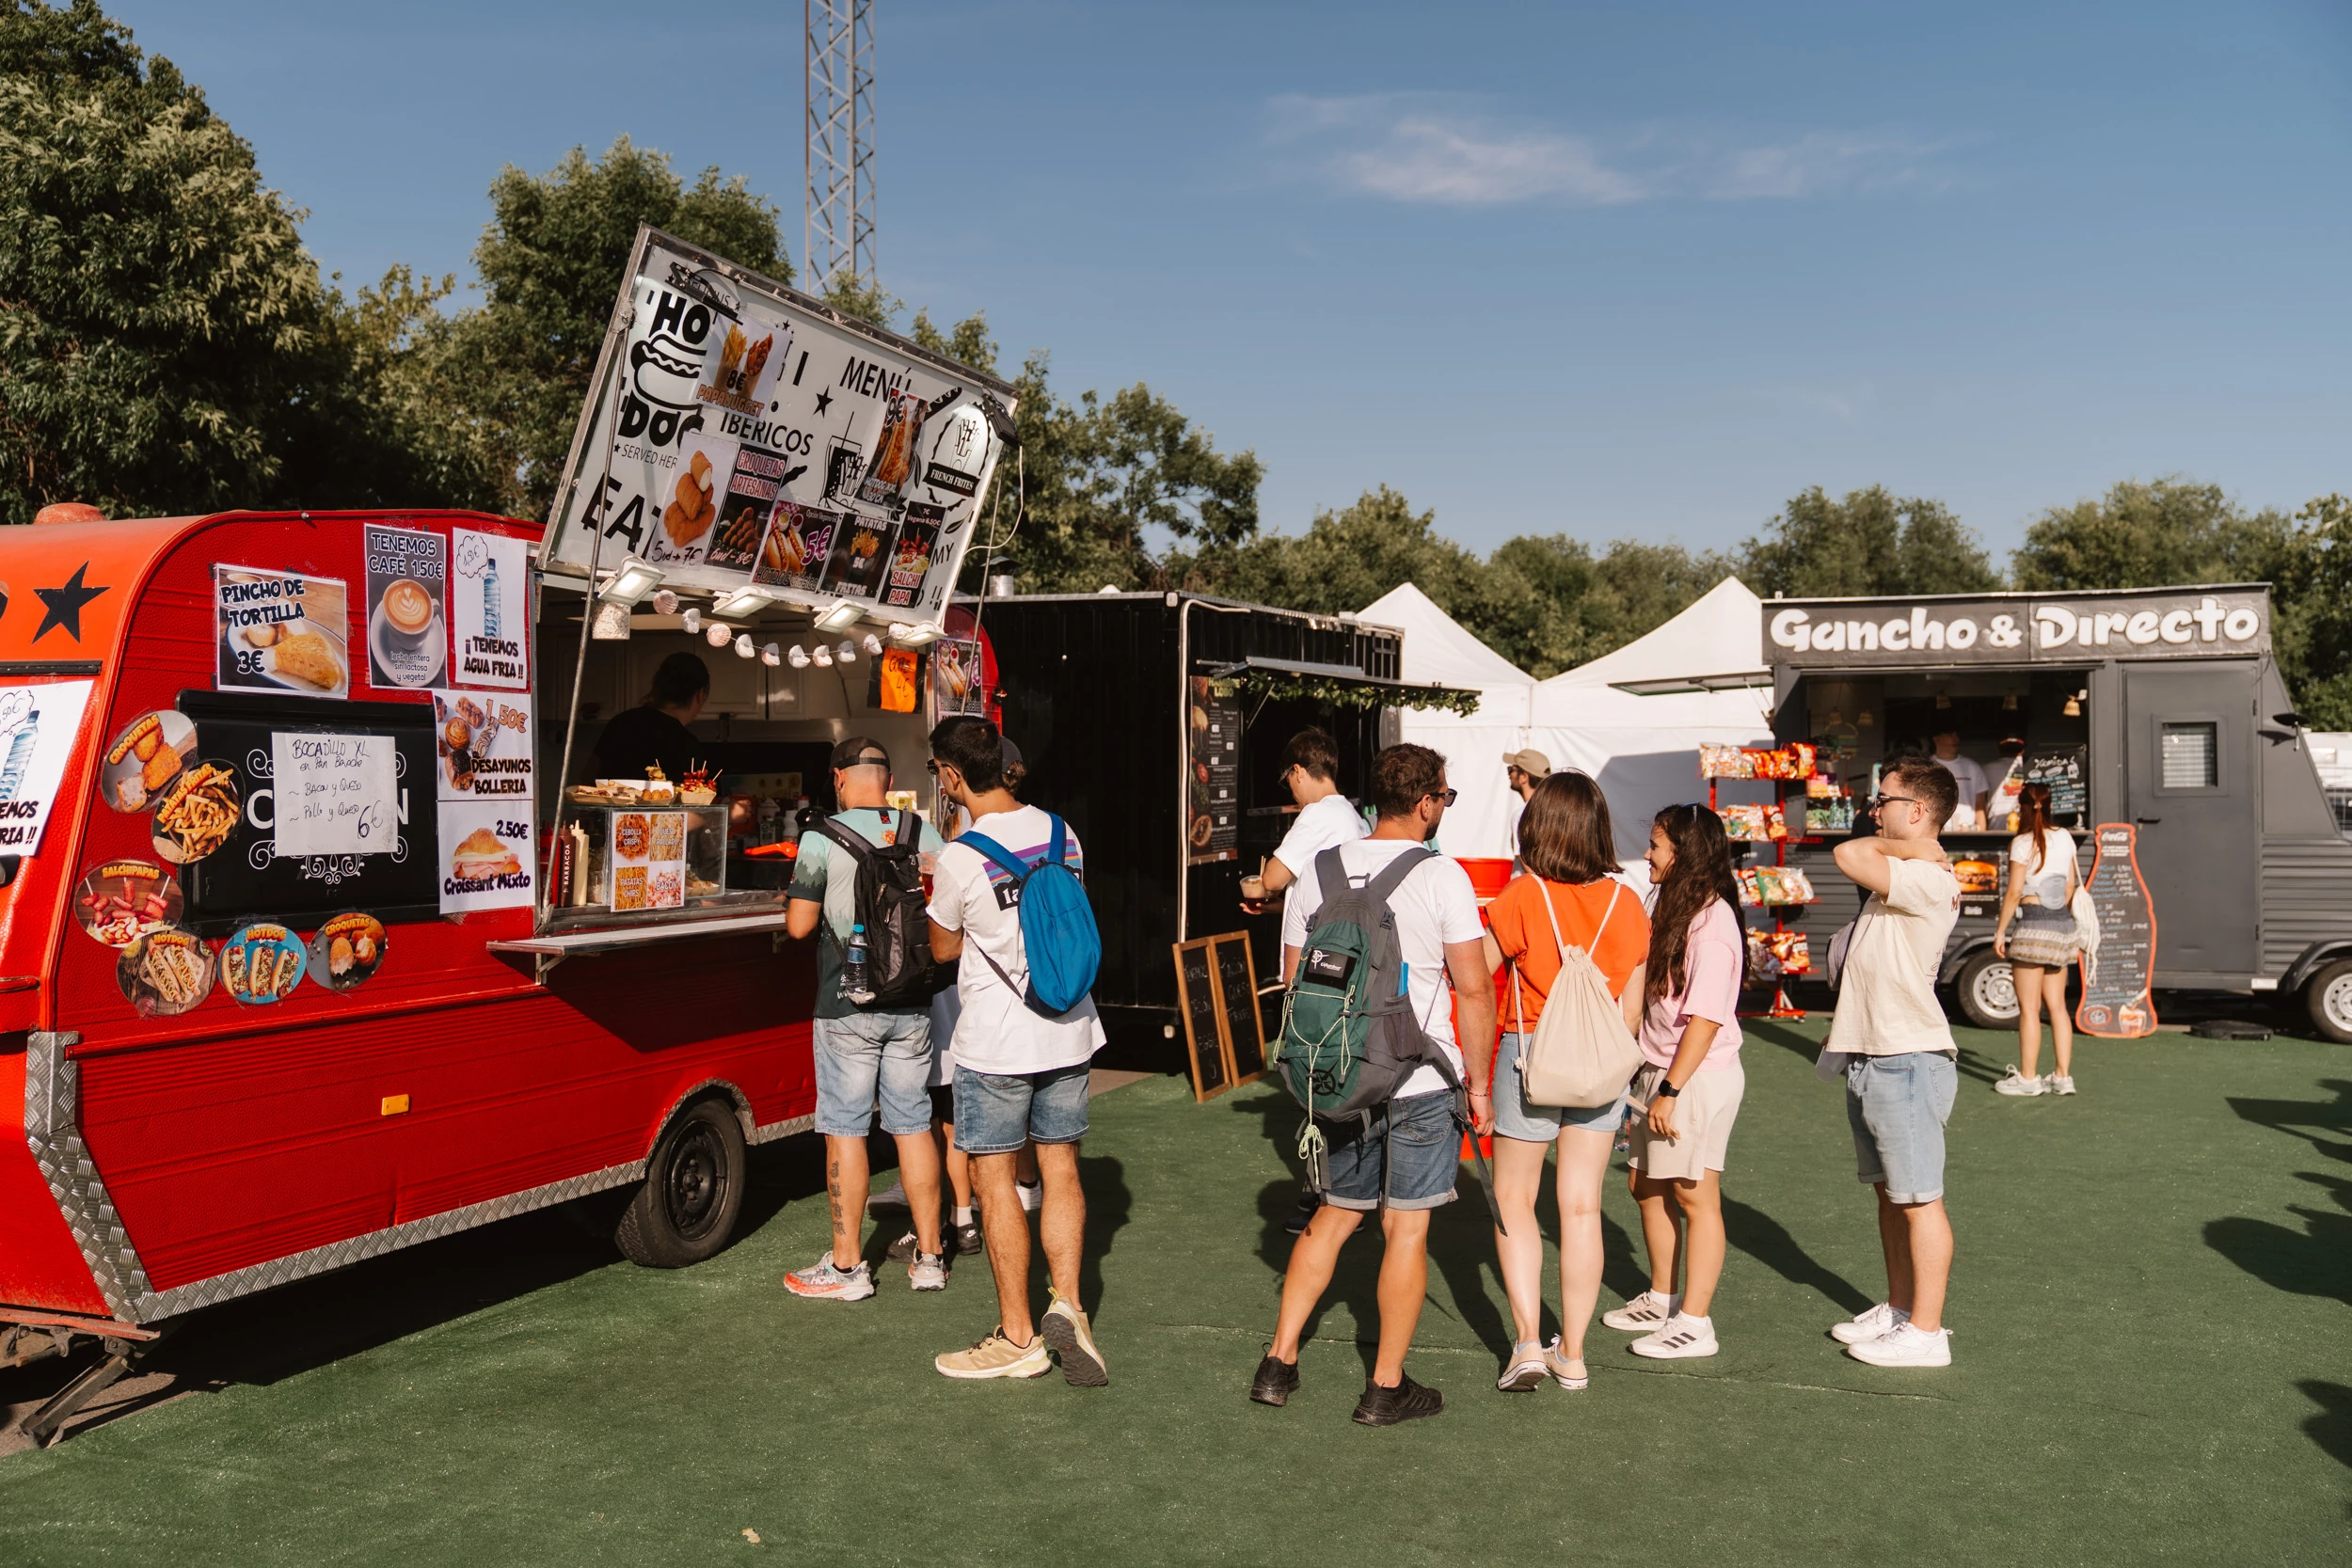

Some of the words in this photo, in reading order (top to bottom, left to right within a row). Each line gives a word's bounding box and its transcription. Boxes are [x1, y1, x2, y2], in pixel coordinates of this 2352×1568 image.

[649, 291, 718, 345] HO
[726, 370, 747, 391] 8€
[696, 384, 765, 419] PAPANUGGET
[885, 395, 906, 428] 9€
[621, 443, 659, 466] SERVED
[659, 456, 678, 469] HER
[737, 450, 786, 480] CROQUETAS
[729, 473, 779, 502] ARTESANAS
[864, 476, 886, 488] HOTDOG
[930, 467, 953, 485] FRENCH
[952, 475, 975, 490] FRITES
[854, 515, 888, 531] PATATAS
[371, 532, 436, 556] TENEMOS
[801, 525, 832, 565] 5€
[368, 553, 406, 575] CAFÉ
[411, 561, 443, 579] 1.50€
[684, 546, 703, 566] 7€
[736, 551, 754, 565] 8€
[852, 556, 866, 569] 5€
[755, 565, 792, 585] HOTDOG
[890, 570, 922, 589] SALCHI
[221, 579, 281, 605] PINCHO
[283, 578, 306, 597] DE
[835, 580, 867, 596] FRITAS
[887, 588, 913, 605] PAPA
[229, 602, 306, 628] TORTILLA
[1770, 607, 1978, 653] Gancho
[1989, 615, 2023, 649] &
[2035, 597, 2260, 650] Directo
[390, 651, 408, 662] leche
[410, 653, 430, 662] entera
[472, 636, 519, 657] TENEMOS
[237, 649, 265, 674] 3€
[394, 661, 405, 670] sin
[405, 663, 428, 673] lactosa
[463, 657, 491, 676] AGUA
[492, 661, 516, 678] FRIA
[403, 672, 426, 683] vegetal
[1214, 687, 1234, 697] LOBO
[108, 713, 160, 766] CROQUETAS
[292, 738, 346, 760] BOCADILLO
[354, 740, 371, 757] XL
[299, 762, 310, 772] en
[315, 756, 327, 769] Pan
[471, 757, 532, 774] DESAYUNOS
[156, 785, 188, 825] PATATAS
[184, 763, 213, 790] FRITAS
[474, 778, 527, 796] BOLLERIA
[0, 800, 39, 819] EMOS
[304, 802, 323, 820] Pollo
[328, 809, 334, 822] y
[338, 801, 359, 816] Queso
[358, 800, 384, 839] 6€
[0, 827, 27, 845] RIA
[495, 819, 529, 840] 2.50€
[622, 828, 643, 836] CEBOLLA
[102, 865, 161, 880] SALCHIPAPAS
[444, 876, 495, 895] Croissant
[497, 870, 532, 890] Mixto
[621, 877, 644, 886] PATATAS
[623, 889, 640, 898] CHIPS
[656, 880, 677, 891] BACON
[246, 927, 287, 942] HOTDOG
[324, 917, 371, 937] CROQUETAS
[153, 932, 190, 947] HOTDOG
[810, 1274, 838, 1286] HOKA
